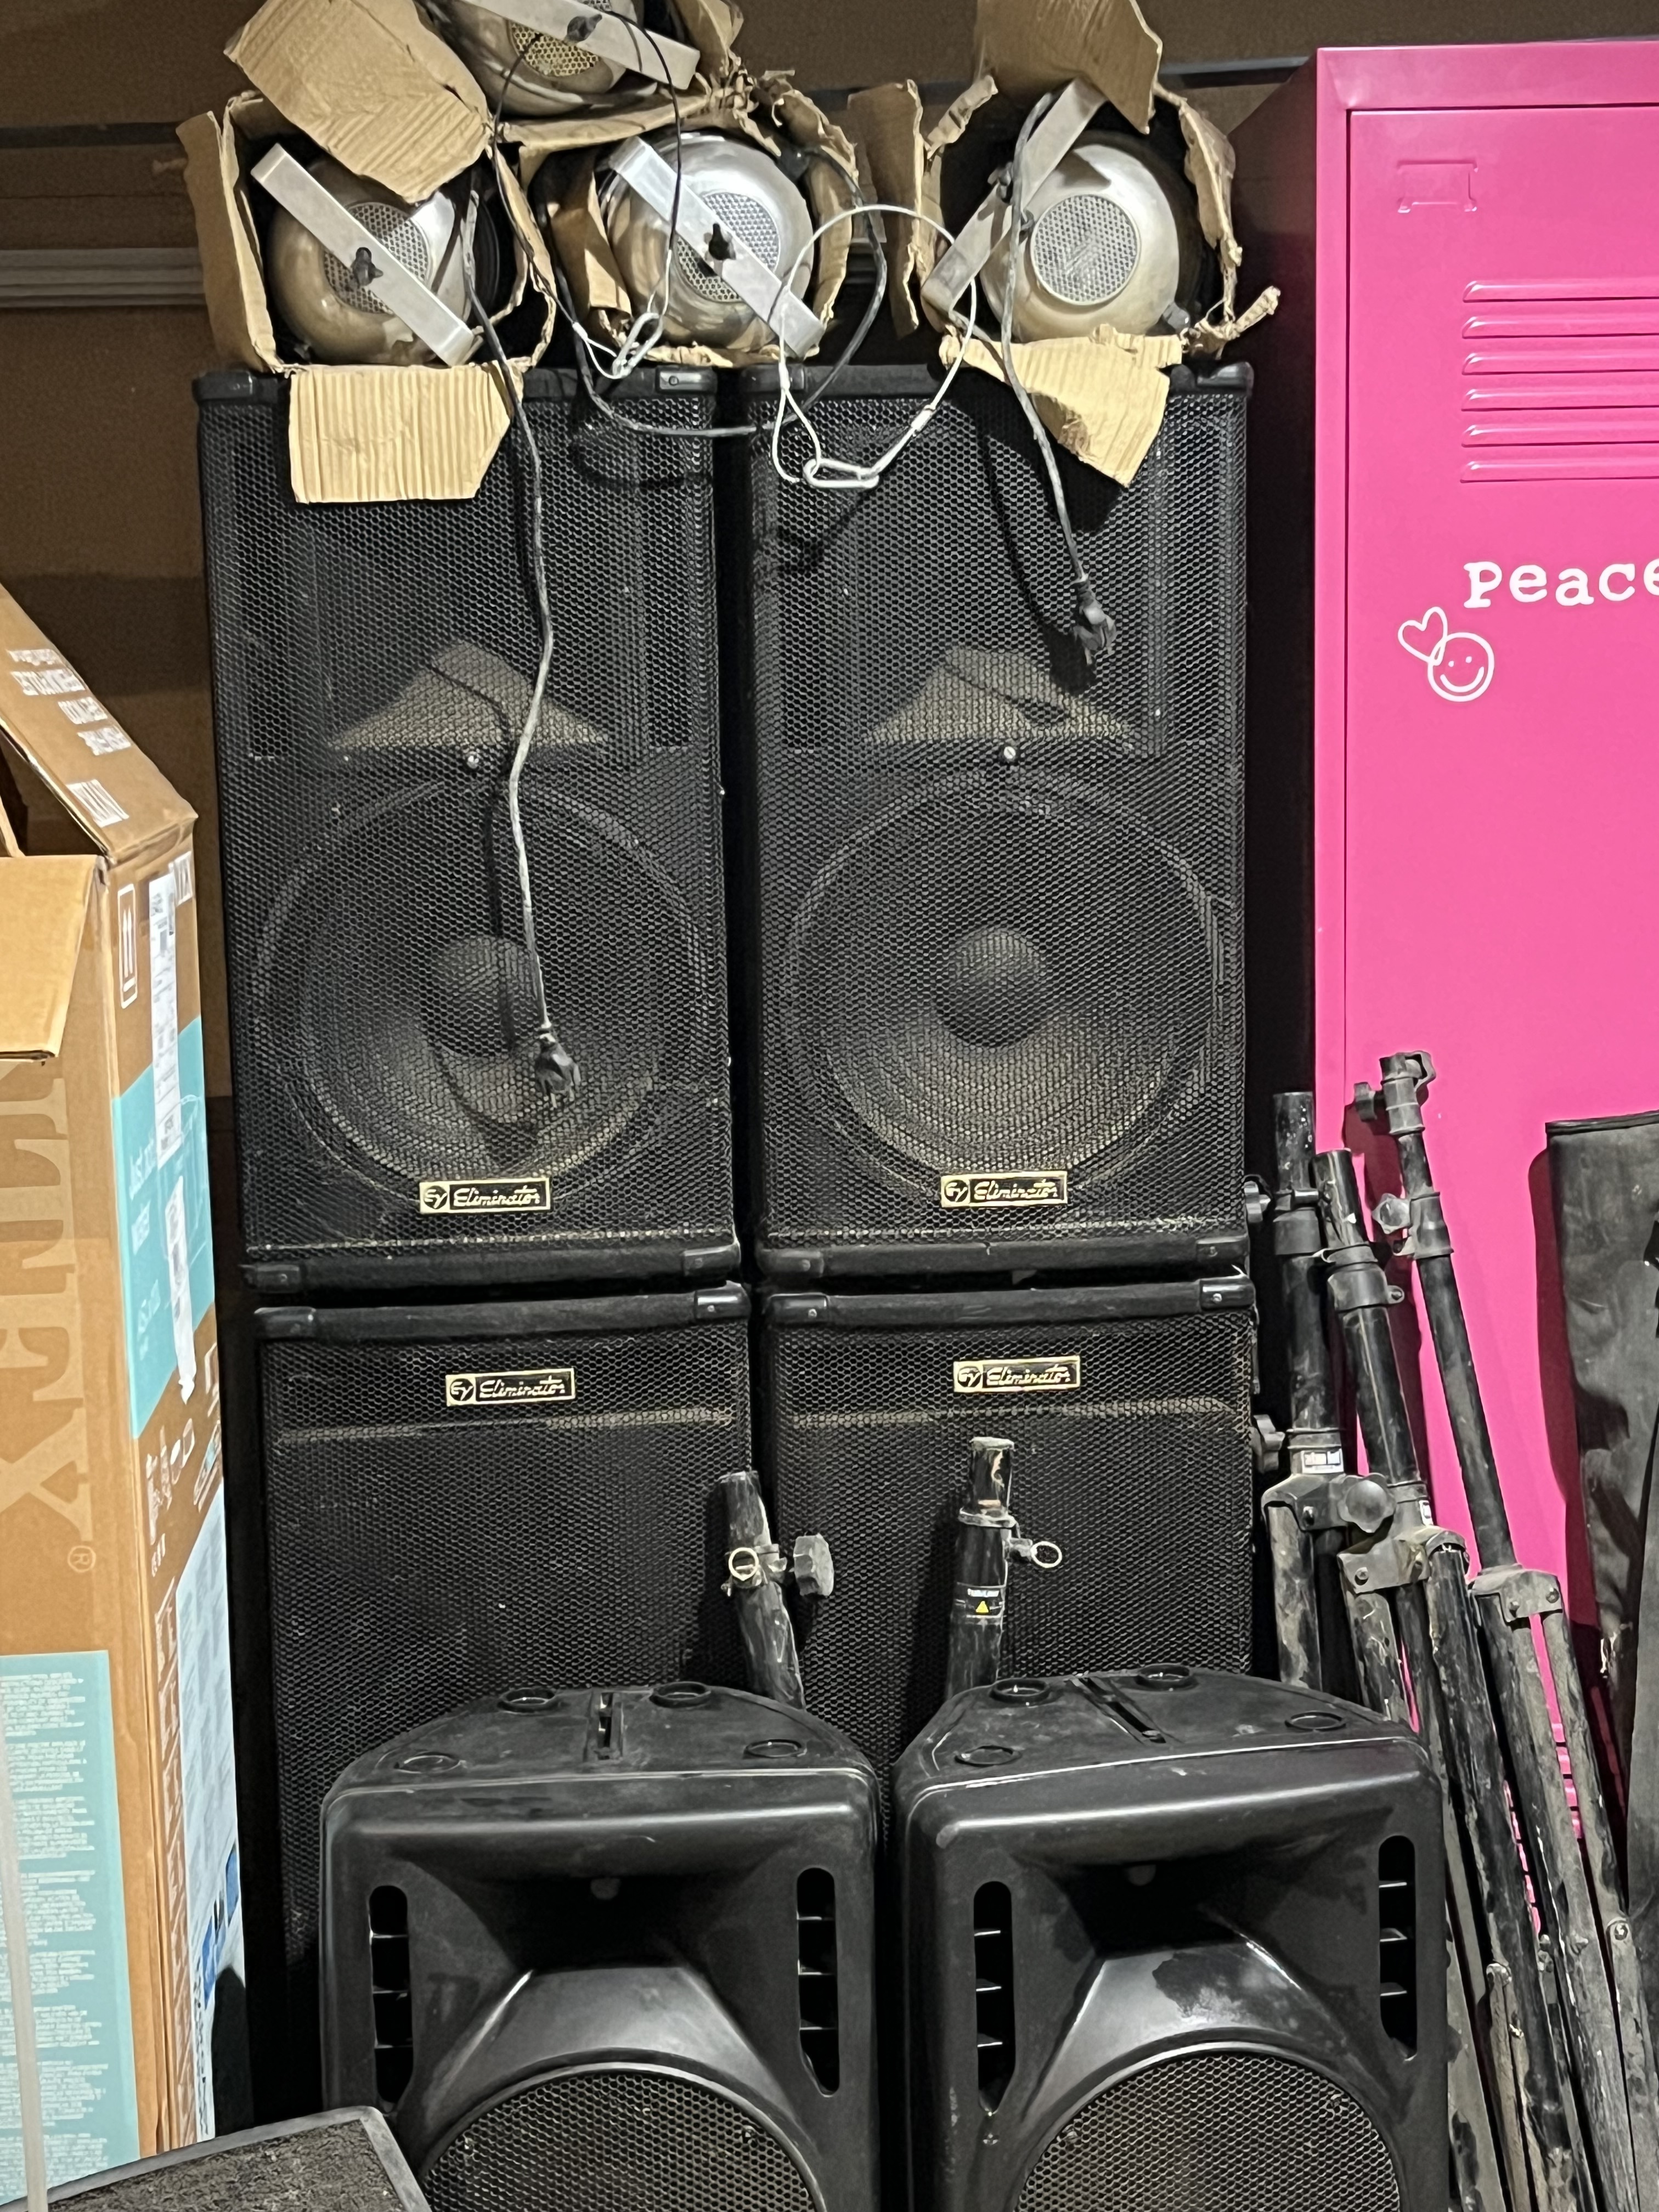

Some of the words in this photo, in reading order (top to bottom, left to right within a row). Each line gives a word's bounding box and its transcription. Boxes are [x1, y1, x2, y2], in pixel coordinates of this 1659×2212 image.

[453, 1185, 540, 1206] Eliminator
[973, 1179, 1058, 1200] Eliminator
[986, 1364, 1071, 1386] Eliminator
[479, 1375, 566, 1398] Eliminator
